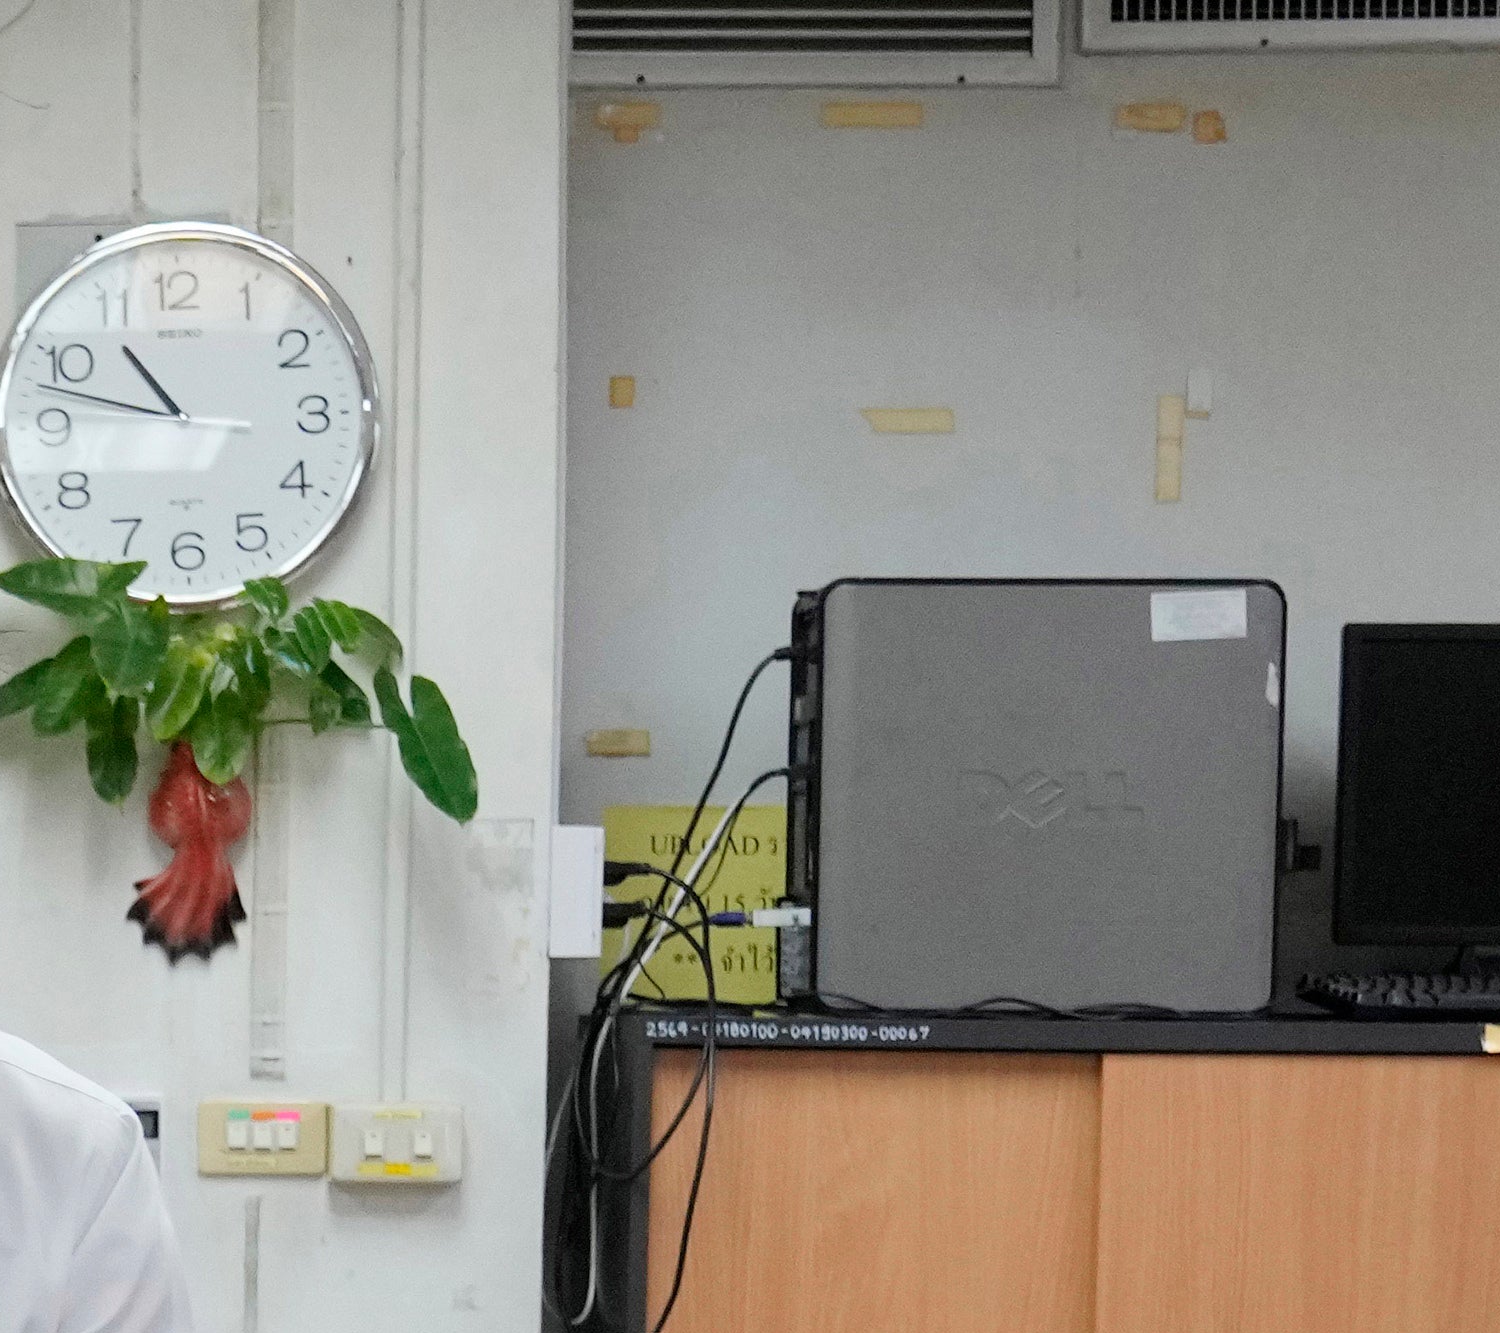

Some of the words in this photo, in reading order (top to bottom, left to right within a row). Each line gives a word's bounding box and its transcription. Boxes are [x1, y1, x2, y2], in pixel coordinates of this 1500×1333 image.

[97, 286, 129, 327] 11
[154, 271, 199, 311] 12
[239, 281, 251, 320] 1
[46, 344, 93, 383] 10
[277, 329, 310, 369] 2
[36, 408, 71, 447] 9
[297, 395, 330, 434] 3
[58, 472, 91, 510] 8
[279, 460, 313, 498] 4
[111, 518, 142, 557] 7
[171, 532, 206, 570] 6
[235, 513, 268, 552] 5
